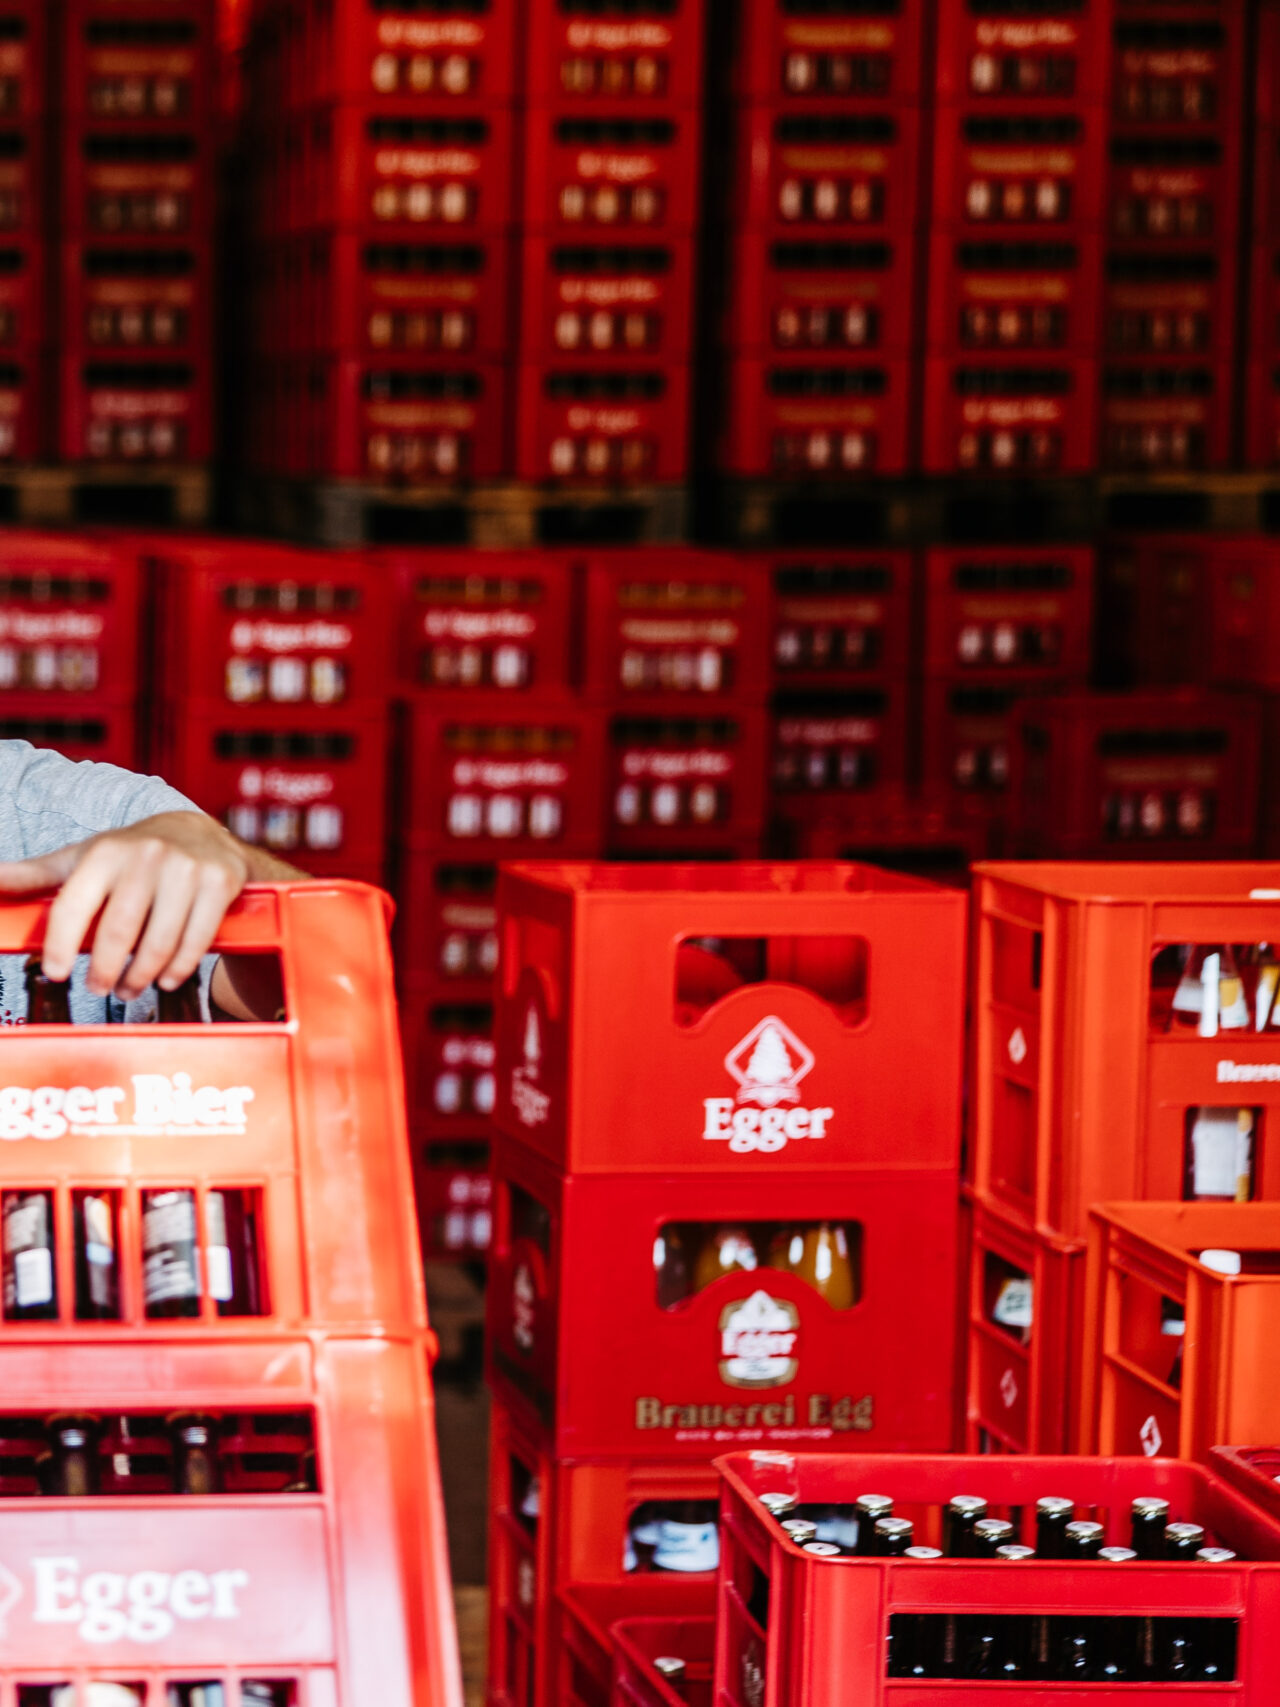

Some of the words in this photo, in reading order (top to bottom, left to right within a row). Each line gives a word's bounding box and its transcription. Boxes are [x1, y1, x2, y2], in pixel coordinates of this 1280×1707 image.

[131, 1072, 255, 1125] Bier
[702, 1097, 834, 1152] Egger
[634, 1394, 796, 1430] Brauerei
[808, 1393, 873, 1431] Egg
[30, 1555, 250, 1643] Egger
